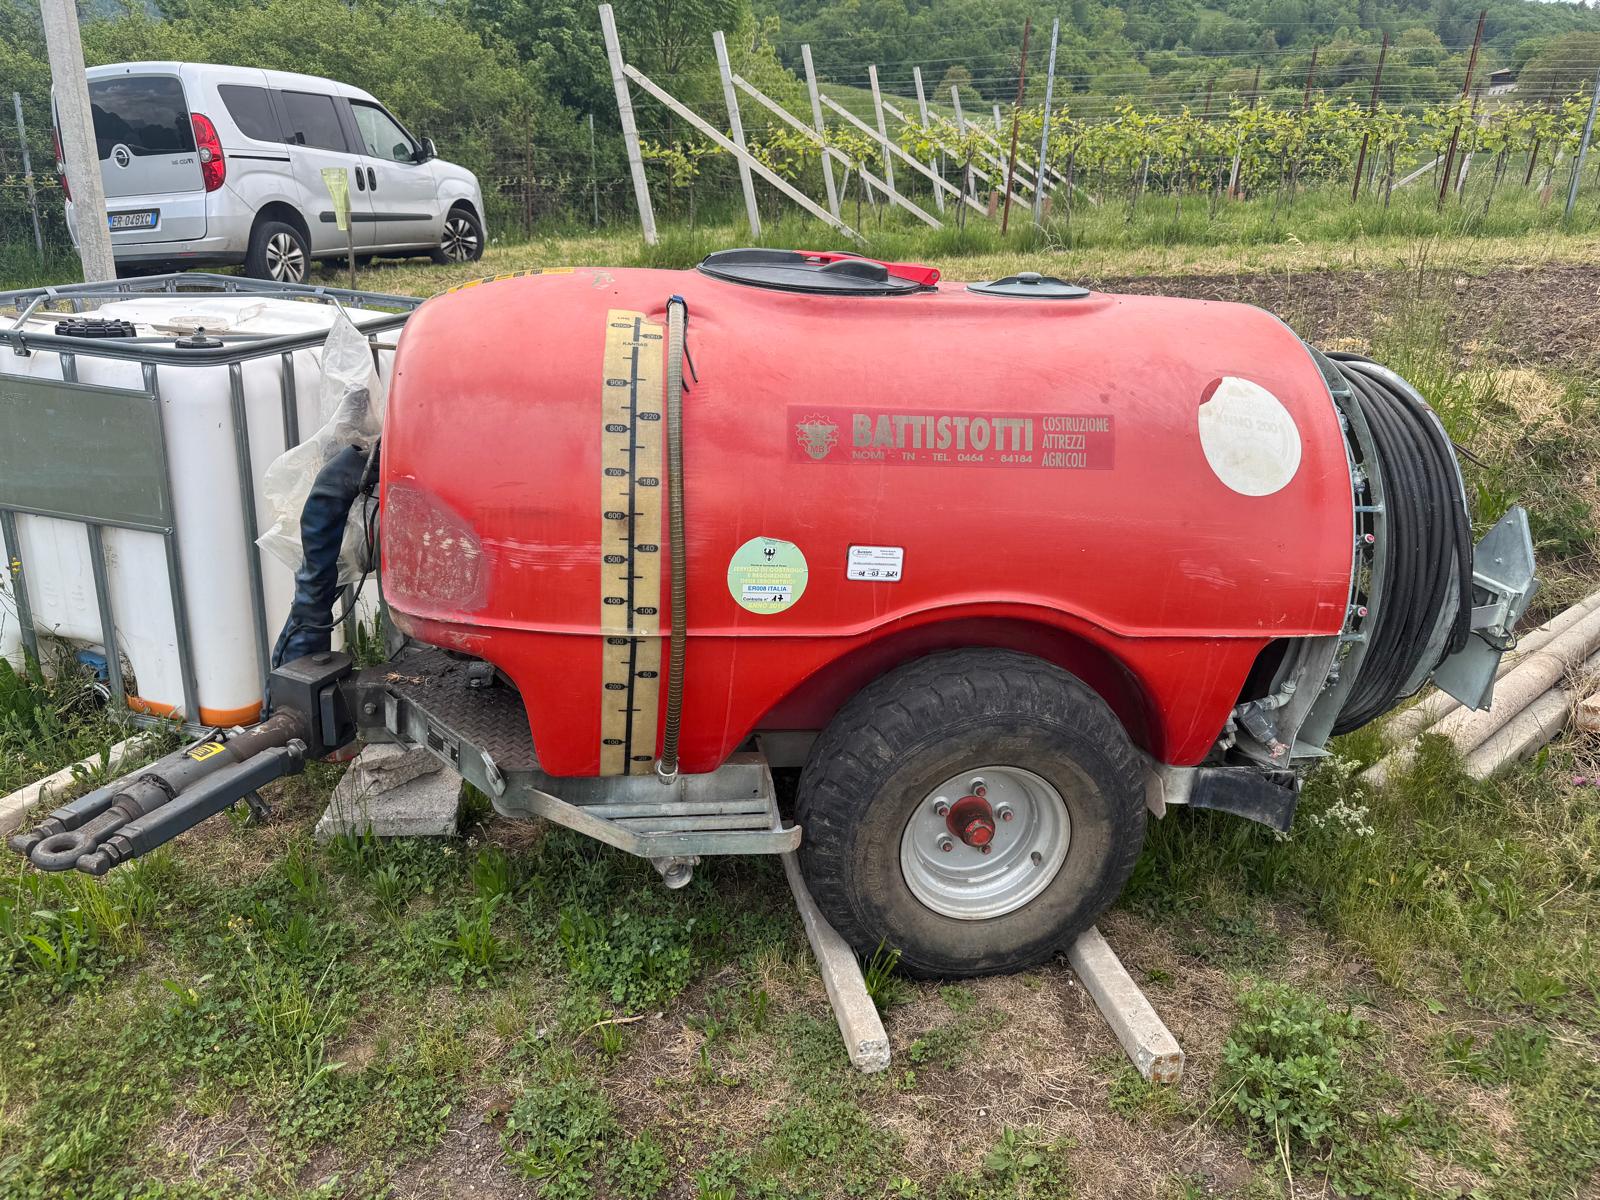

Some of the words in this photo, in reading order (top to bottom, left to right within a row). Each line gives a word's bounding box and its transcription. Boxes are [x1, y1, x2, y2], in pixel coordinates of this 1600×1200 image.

[112, 215, 123, 227] ER
[852, 413, 1034, 451] BATTISTOTTI
[1042, 416, 1110, 432] COSTRUZIONE
[1042, 433, 1086, 450] ATTREZZI
[852, 450, 885, 460] NOMI
[901, 452, 916, 461] TN
[932, 452, 952, 462] TEL.
[957, 453, 984, 462] 0464
[1000, 454, 1033, 463] 84184
[1042, 452, 1087, 468] AGRICOLI
